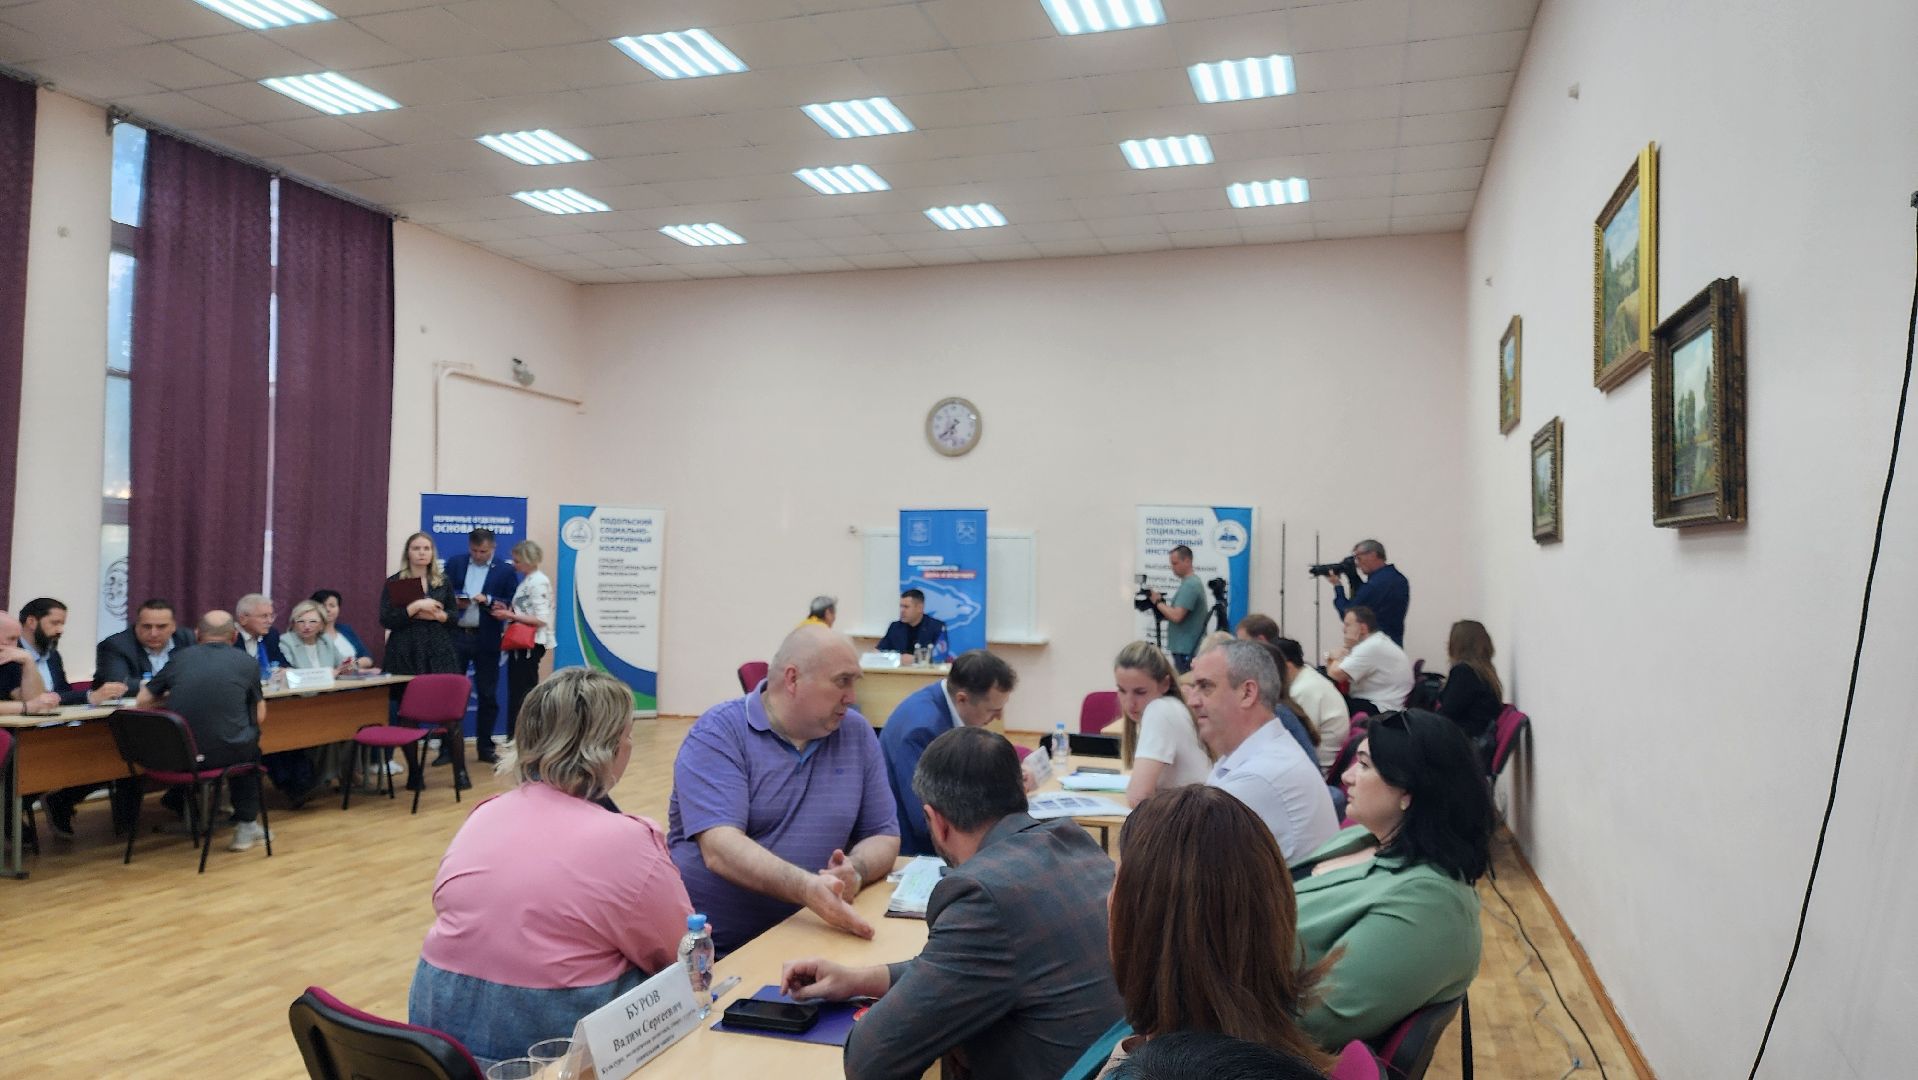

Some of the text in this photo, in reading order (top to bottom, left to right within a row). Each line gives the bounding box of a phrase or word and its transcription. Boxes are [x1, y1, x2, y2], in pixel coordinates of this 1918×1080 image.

[1146, 517, 1203, 526] ПОДОЛЬСКИЙ
[433, 523, 473, 534] ОСНОВА
[1146, 528, 1200, 536] СОЦИАЛЬНО-
[1145, 538, 1203, 546] СПОРТИВНЫЙ
[599, 545, 639, 553] КОЛЛЕДЖ
[625, 990, 661, 1020] БУРОВ
[612, 1028, 642, 1052] Вадим
[642, 1001, 683, 1033] Сергеевич
